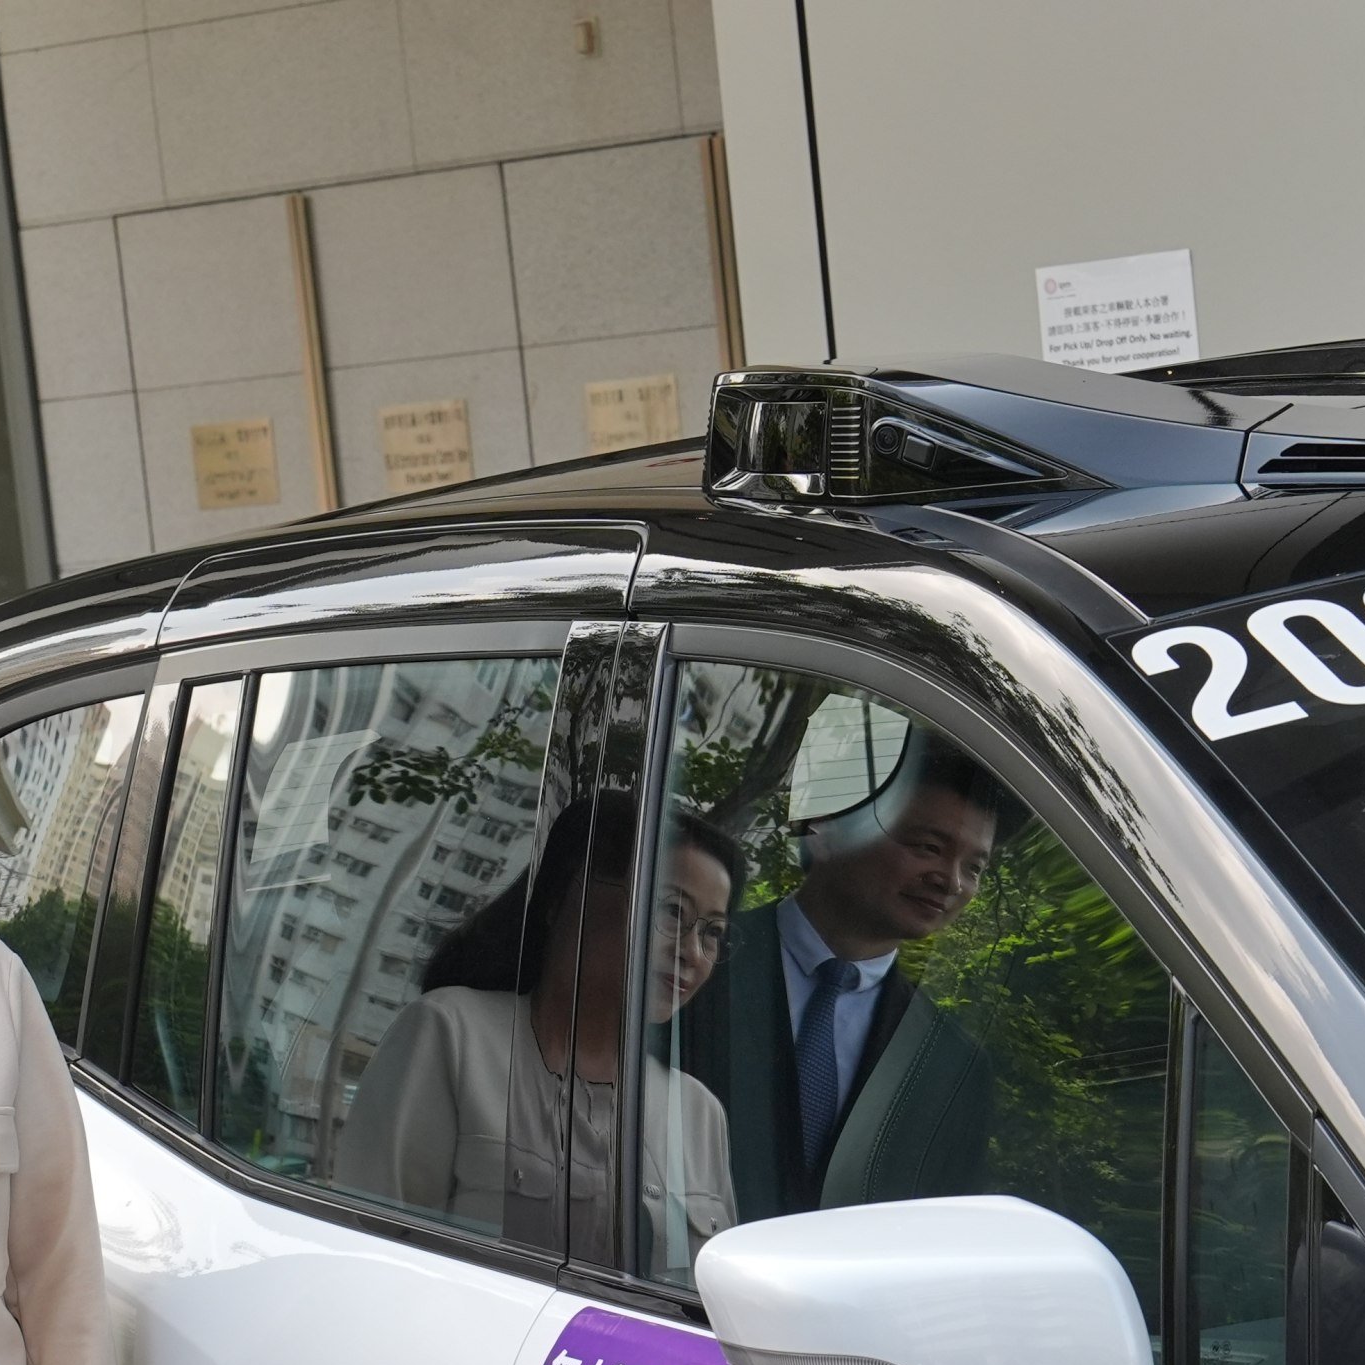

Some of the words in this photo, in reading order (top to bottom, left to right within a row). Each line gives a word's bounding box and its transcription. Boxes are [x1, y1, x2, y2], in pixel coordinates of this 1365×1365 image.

[1049, 344, 1062, 353] For
[1063, 341, 1079, 351] Pick
[1095, 337, 1114, 349] Drop
[1115, 335, 1128, 345] Off
[1149, 332, 1161, 341] No
[1062, 357, 1084, 367] Thank
[1086, 358, 1101, 367] you
[1101, 354, 1113, 364] for
[1113, 353, 1131, 364] your
